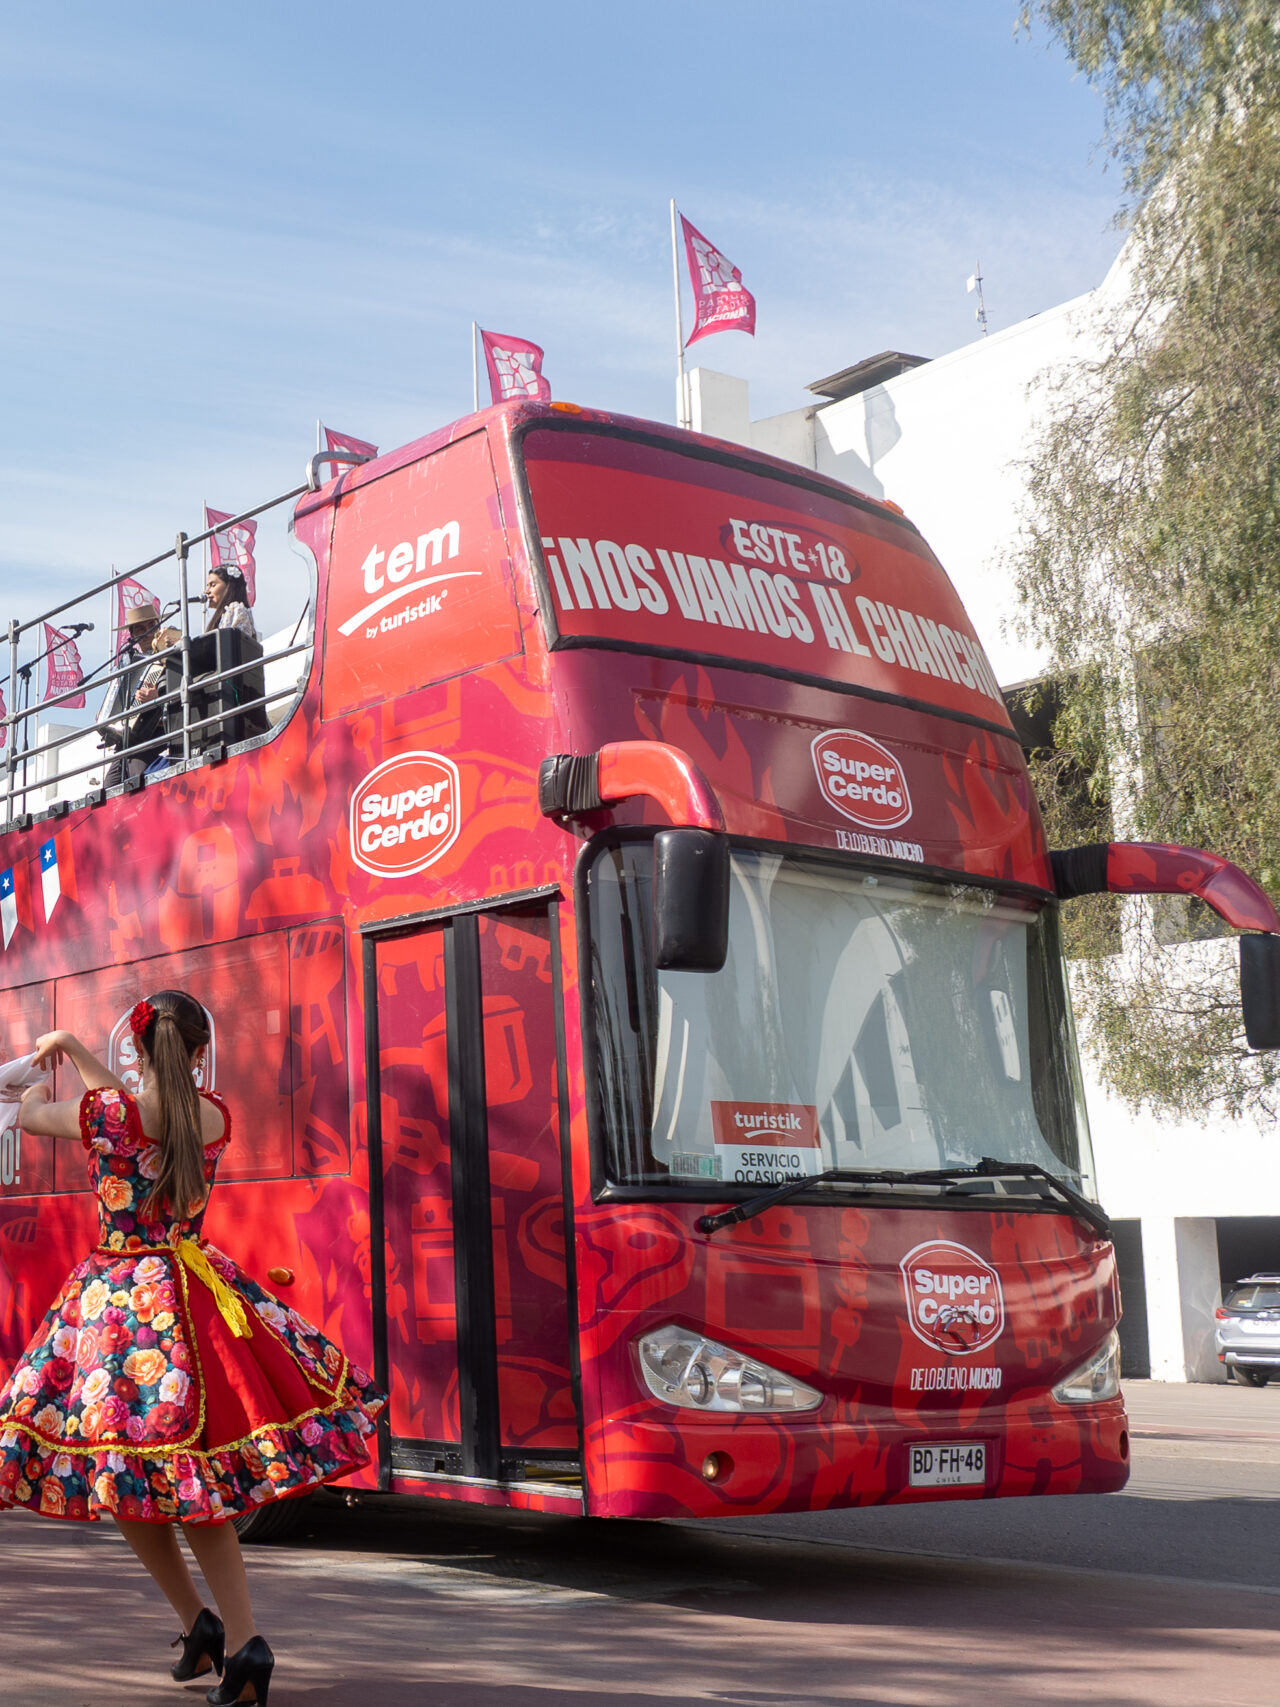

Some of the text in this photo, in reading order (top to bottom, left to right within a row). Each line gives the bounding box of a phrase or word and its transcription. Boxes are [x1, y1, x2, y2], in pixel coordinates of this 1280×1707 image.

[361, 520, 460, 594] tem
[729, 518, 852, 585] ESTE 18
[542, 536, 669, 616] ¡NOS
[664, 551, 815, 644] VAMOS
[807, 581, 872, 658] AL
[366, 626, 379, 639] by
[822, 750, 896, 782] Super
[361, 779, 449, 823] Super
[828, 775, 902, 808] Cerdo
[361, 809, 449, 853] Cerdo
[835, 829, 850, 850] DE
[848, 832, 861, 851] LO
[890, 839, 924, 863] MUCHO
[734, 1111, 802, 1130] turistik
[741, 1152, 800, 1168] SERVICIO
[915, 1269, 991, 1300] Super
[910, 1368, 925, 1391] DE
[923, 1367, 937, 1391] LO
[968, 1367, 1002, 1390] MUCHO
